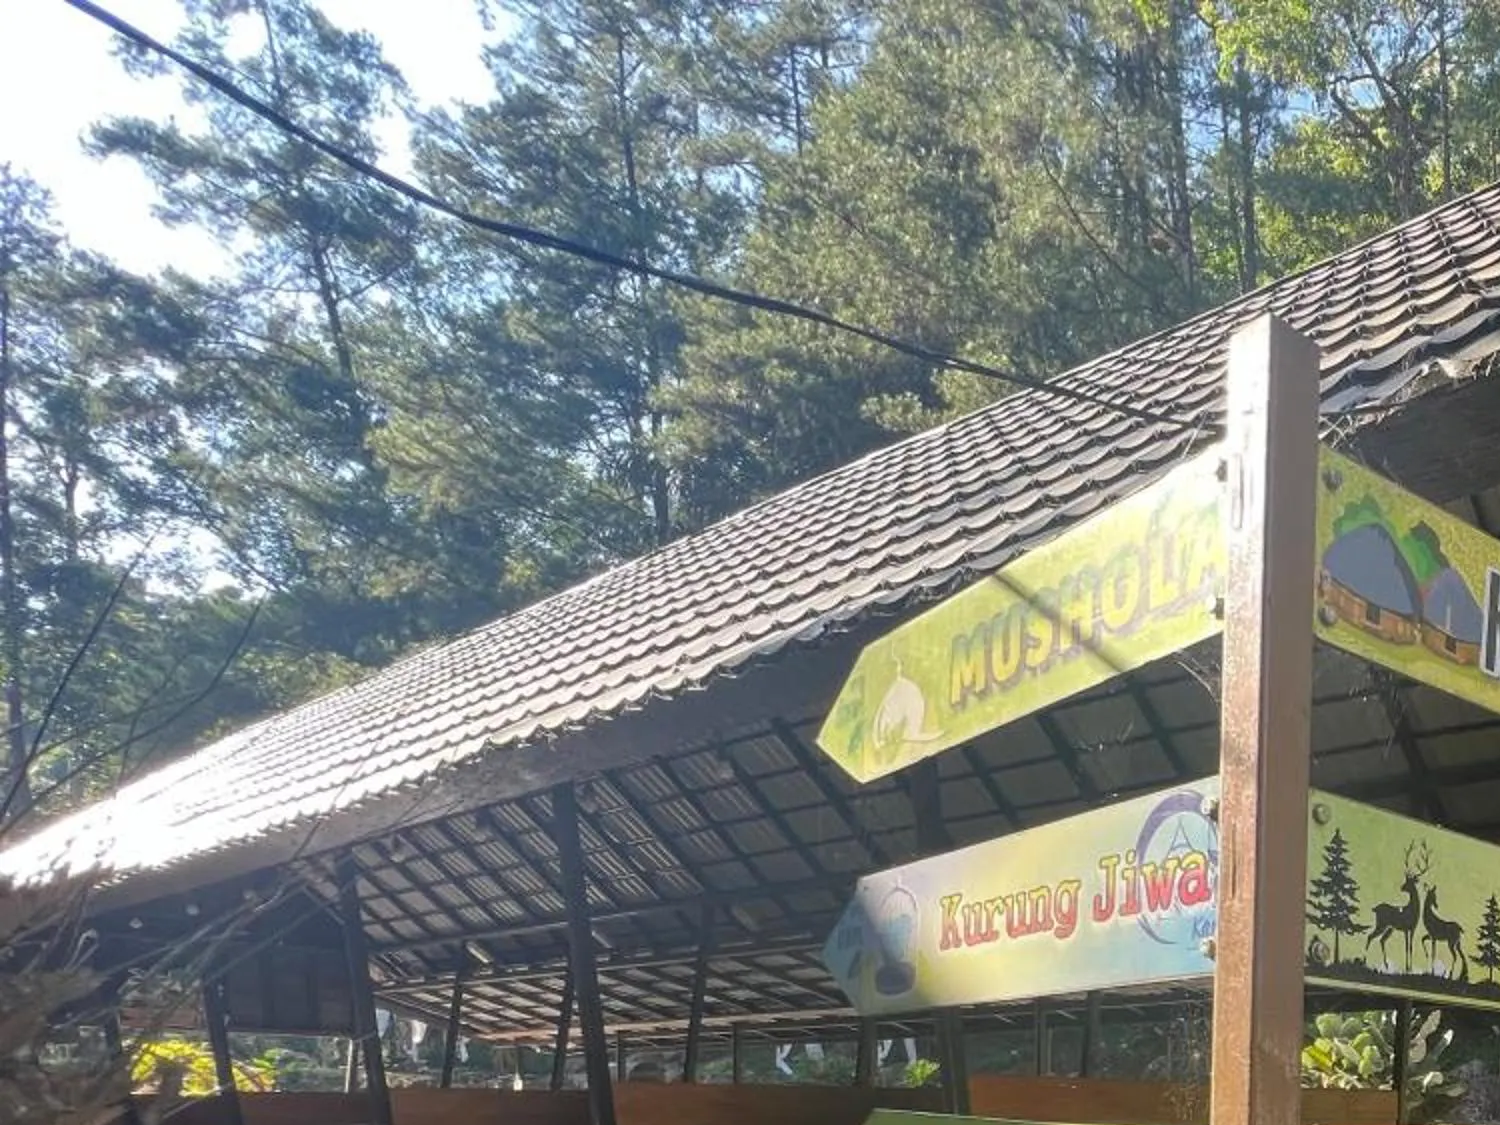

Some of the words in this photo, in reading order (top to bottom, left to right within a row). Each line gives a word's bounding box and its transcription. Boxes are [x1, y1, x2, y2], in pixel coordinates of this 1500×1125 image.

[949, 490, 1228, 712] MUSHOLA
[939, 878, 1082, 952] Kurung
[1091, 846, 1213, 924] Jiwa
